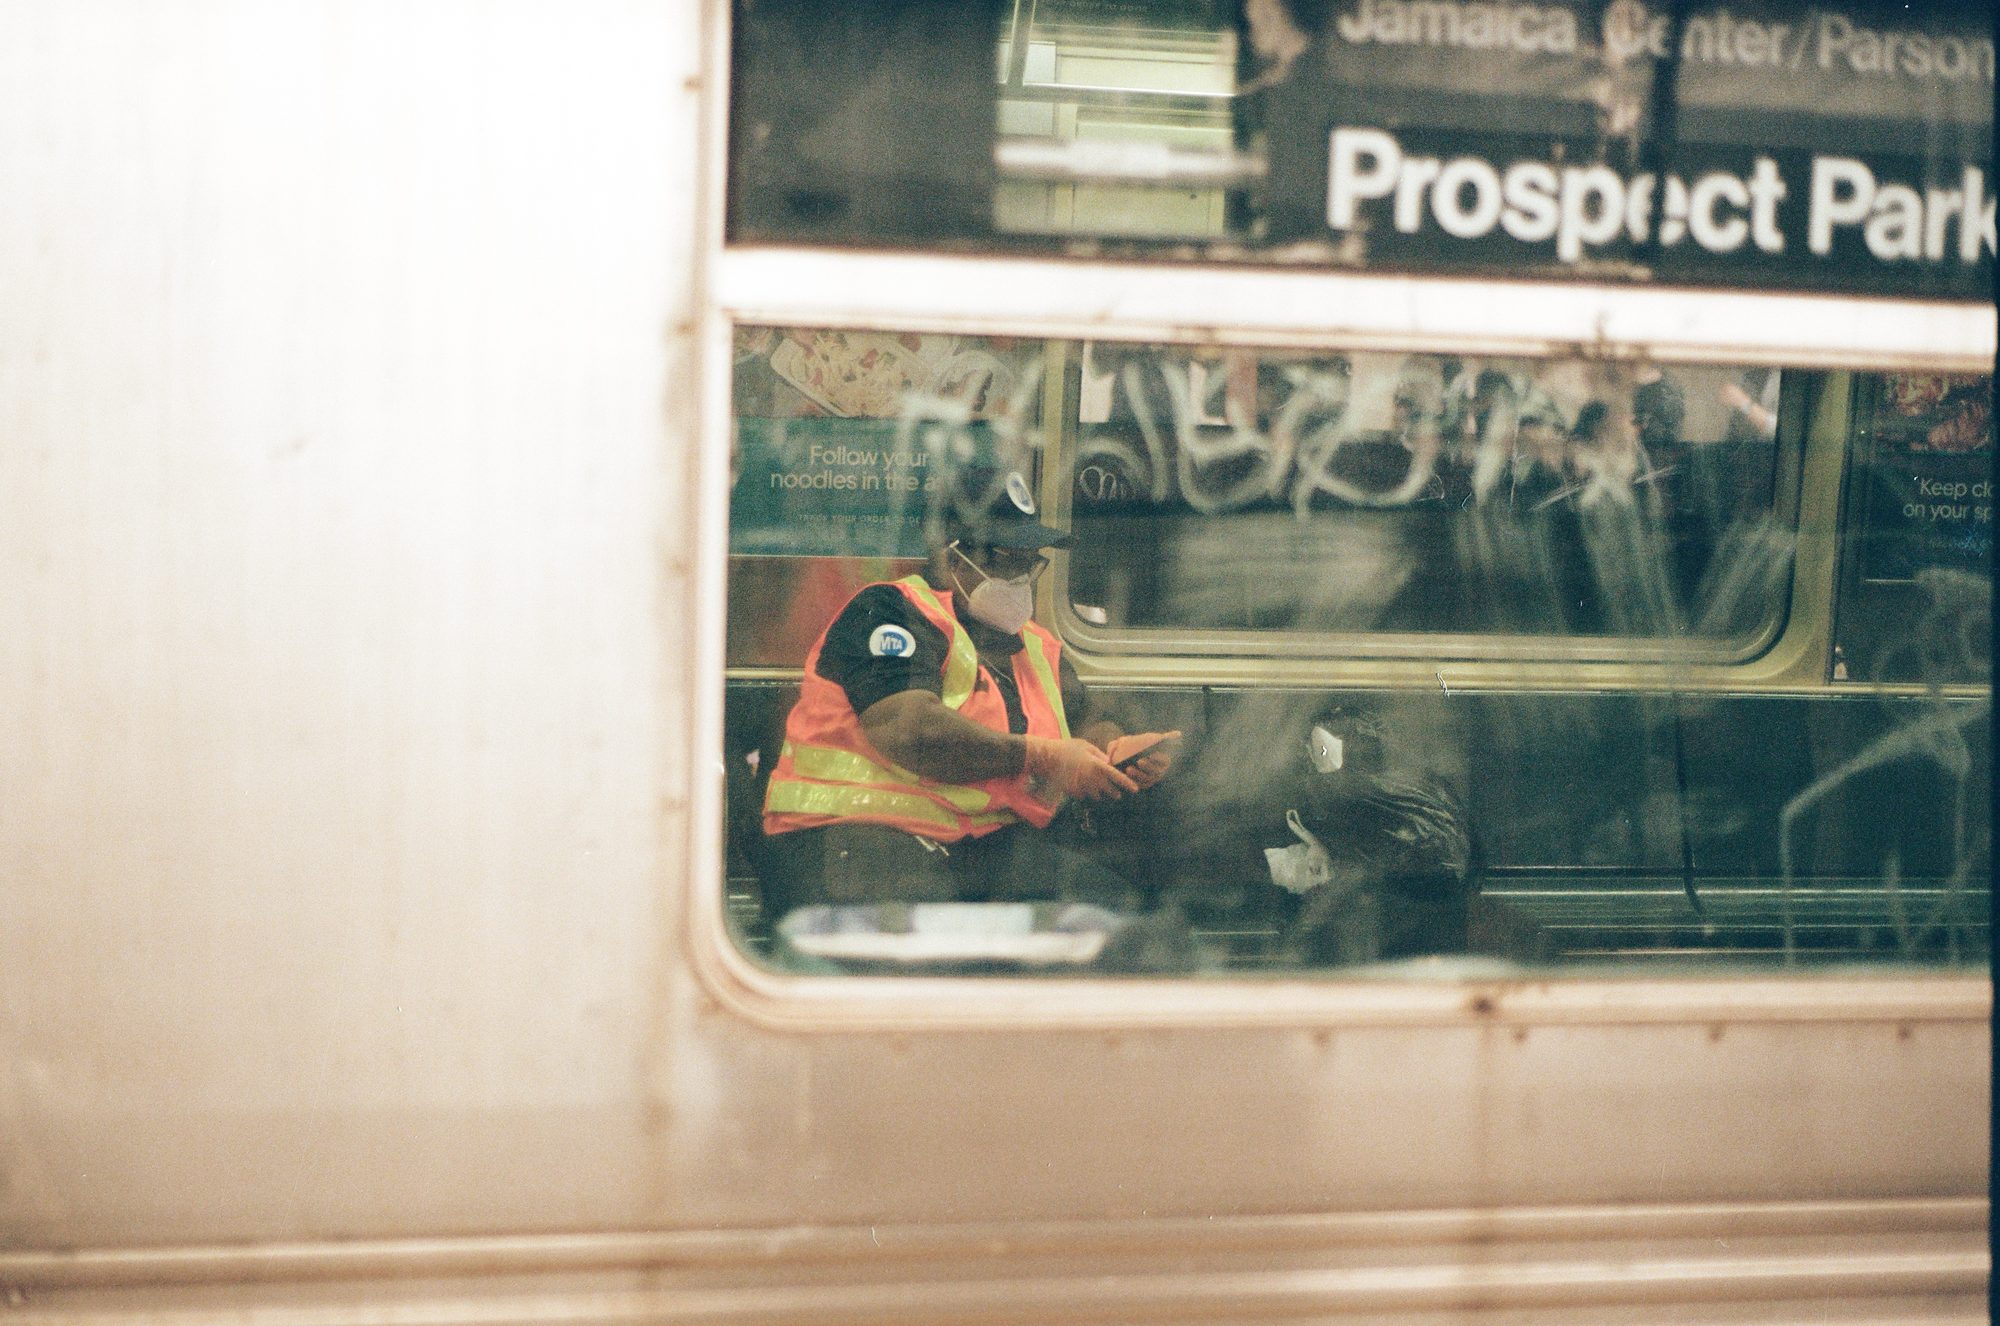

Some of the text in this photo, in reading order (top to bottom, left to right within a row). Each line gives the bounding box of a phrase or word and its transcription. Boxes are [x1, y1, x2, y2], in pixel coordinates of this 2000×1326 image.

[1338, 0, 1577, 53] Jamaica
[1327, 126, 1998, 263] Prospect Park
[809, 444, 928, 471] Follow your
[770, 469, 857, 490] noodles
[862, 471, 880, 490] in
[885, 471, 919, 491] the
[1920, 478, 1968, 500] Keep
[1903, 503, 1926, 518] on
[1929, 504, 1970, 522] your
[880, 635, 903, 651] MTA
